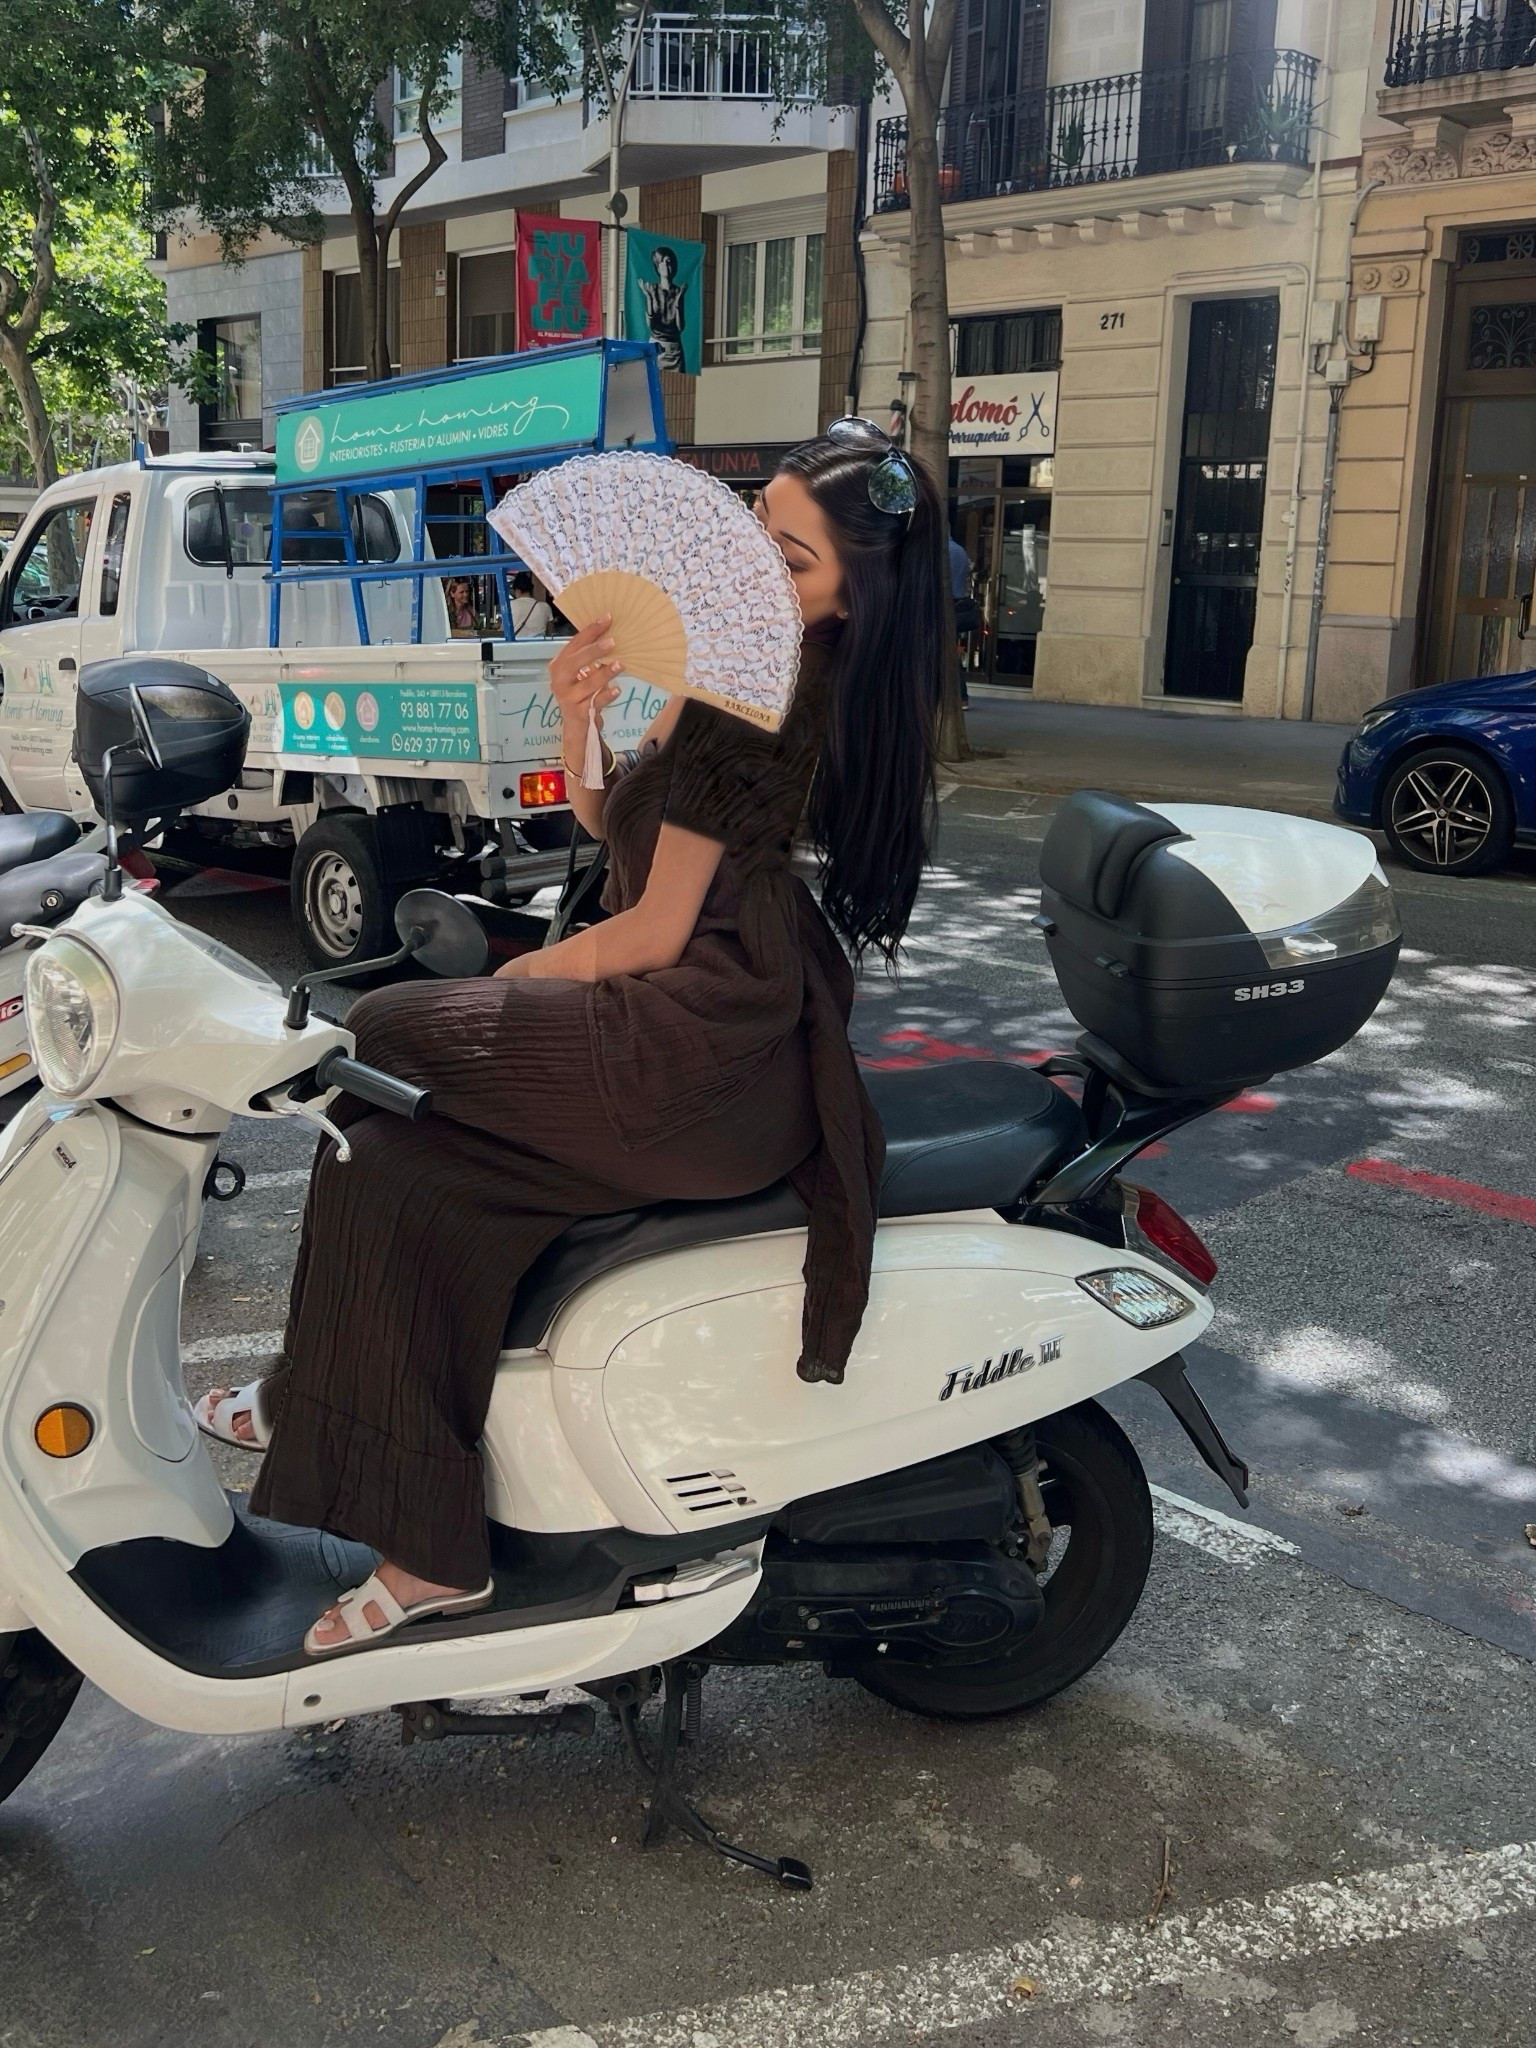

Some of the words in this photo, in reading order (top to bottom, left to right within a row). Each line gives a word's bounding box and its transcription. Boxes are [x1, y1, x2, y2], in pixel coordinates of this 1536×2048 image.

[1100, 312, 1126, 331] 271
[331, 413, 413, 443] home
[329, 443, 383, 463] INTERIORISTES
[389, 438, 426, 454] FUSTERIA
[477, 423, 509, 439] VIDRES
[400, 702, 414, 718] 93
[416, 702, 434, 719] 881
[437, 702, 452, 719] 77
[454, 702, 469, 720] 06
[725, 700, 771, 723] BARCELONA
[404, 736, 423, 753] 629
[425, 737, 438, 754] 37
[440, 737, 454, 755] 77
[457, 738, 471, 756] 19
[1234, 979, 1305, 1002] SH33
[939, 1346, 1036, 1401] Fiddle
